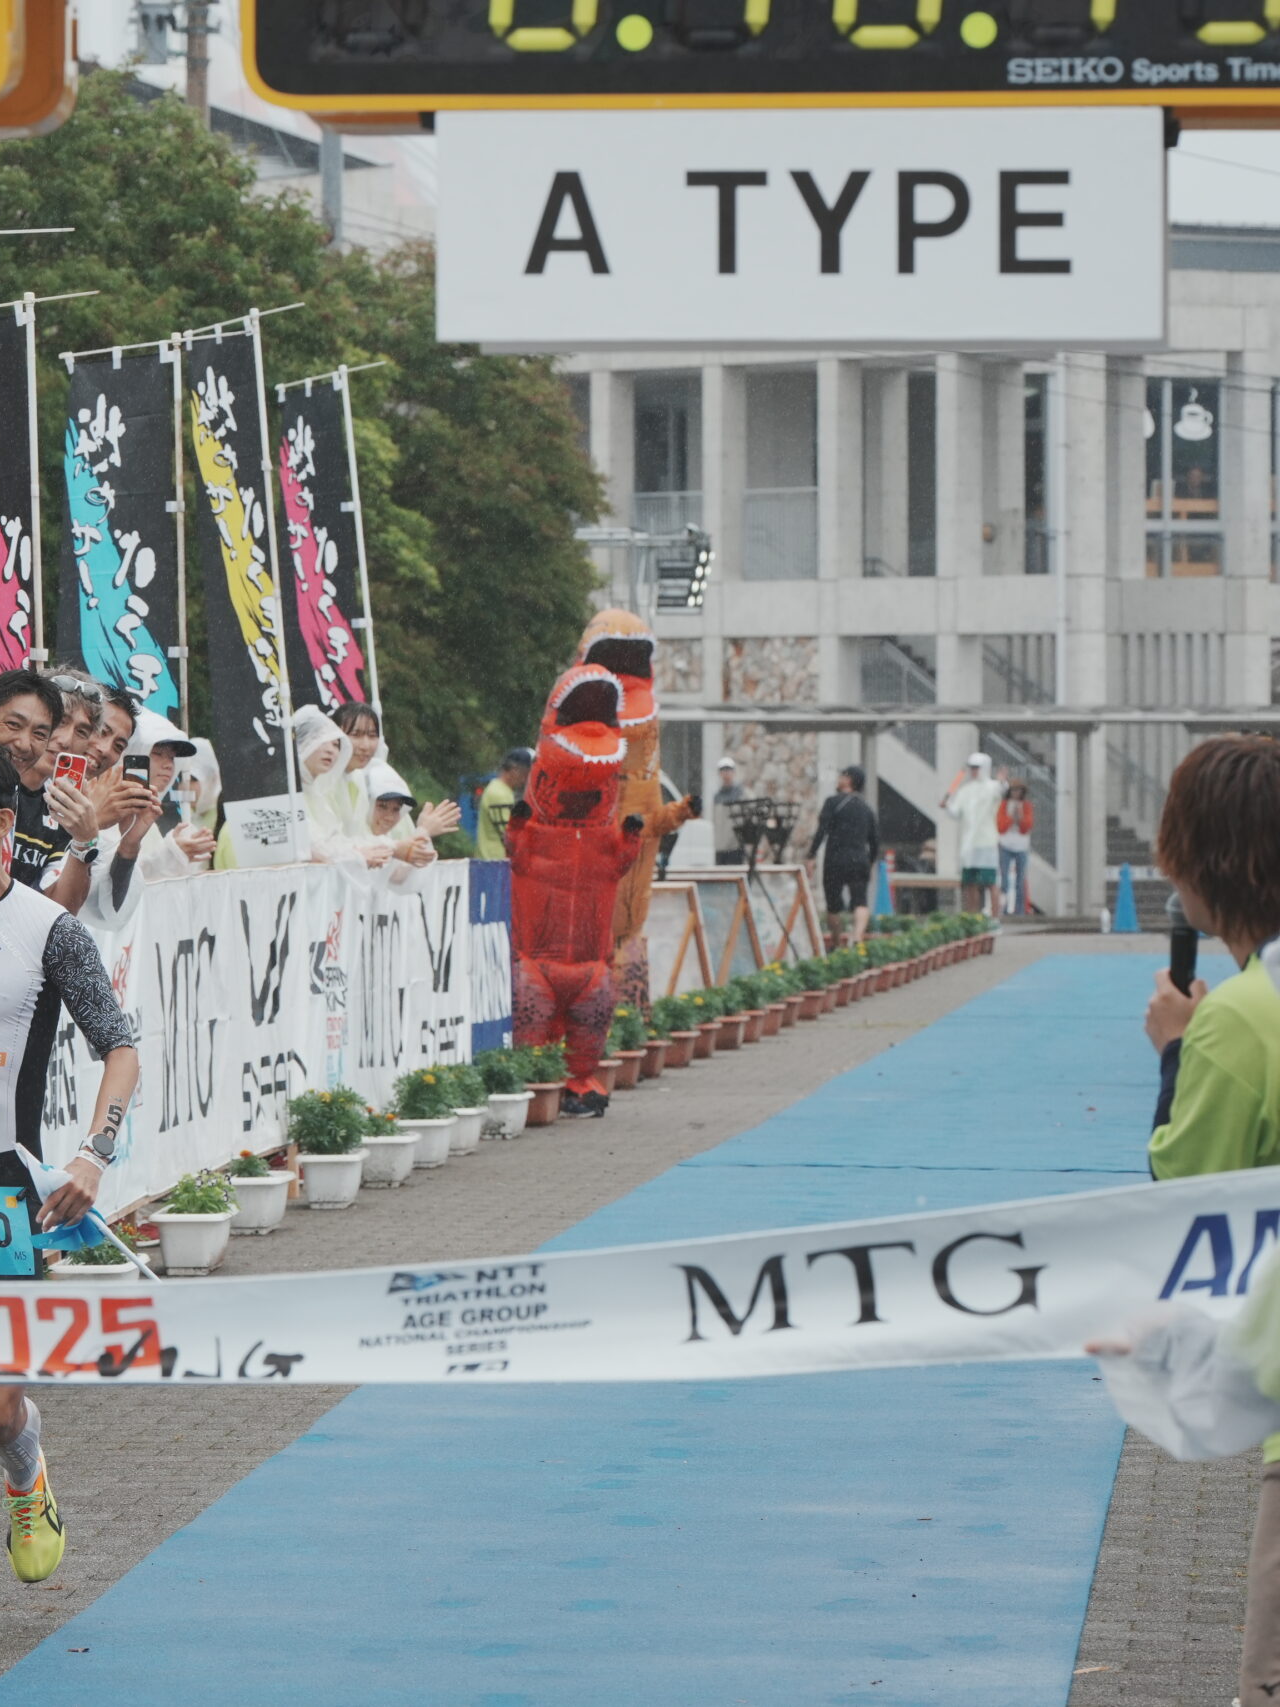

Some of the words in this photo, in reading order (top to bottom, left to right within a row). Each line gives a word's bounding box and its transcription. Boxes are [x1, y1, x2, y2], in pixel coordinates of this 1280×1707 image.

[1007, 57, 1124, 83] SEIKO
[1131, 58, 1219, 85] Sports
[524, 171, 610, 274] A
[686, 170, 1072, 274] TYPE
[476, 1262, 546, 1283] NTT
[402, 1282, 547, 1307] TRIATHLON
[671, 1230, 1047, 1343] MTG
[402, 1310, 452, 1330] AGE
[461, 1303, 548, 1326] GROUP
[358, 1331, 447, 1348] NATIONAL
[445, 1339, 508, 1356] SERIES
